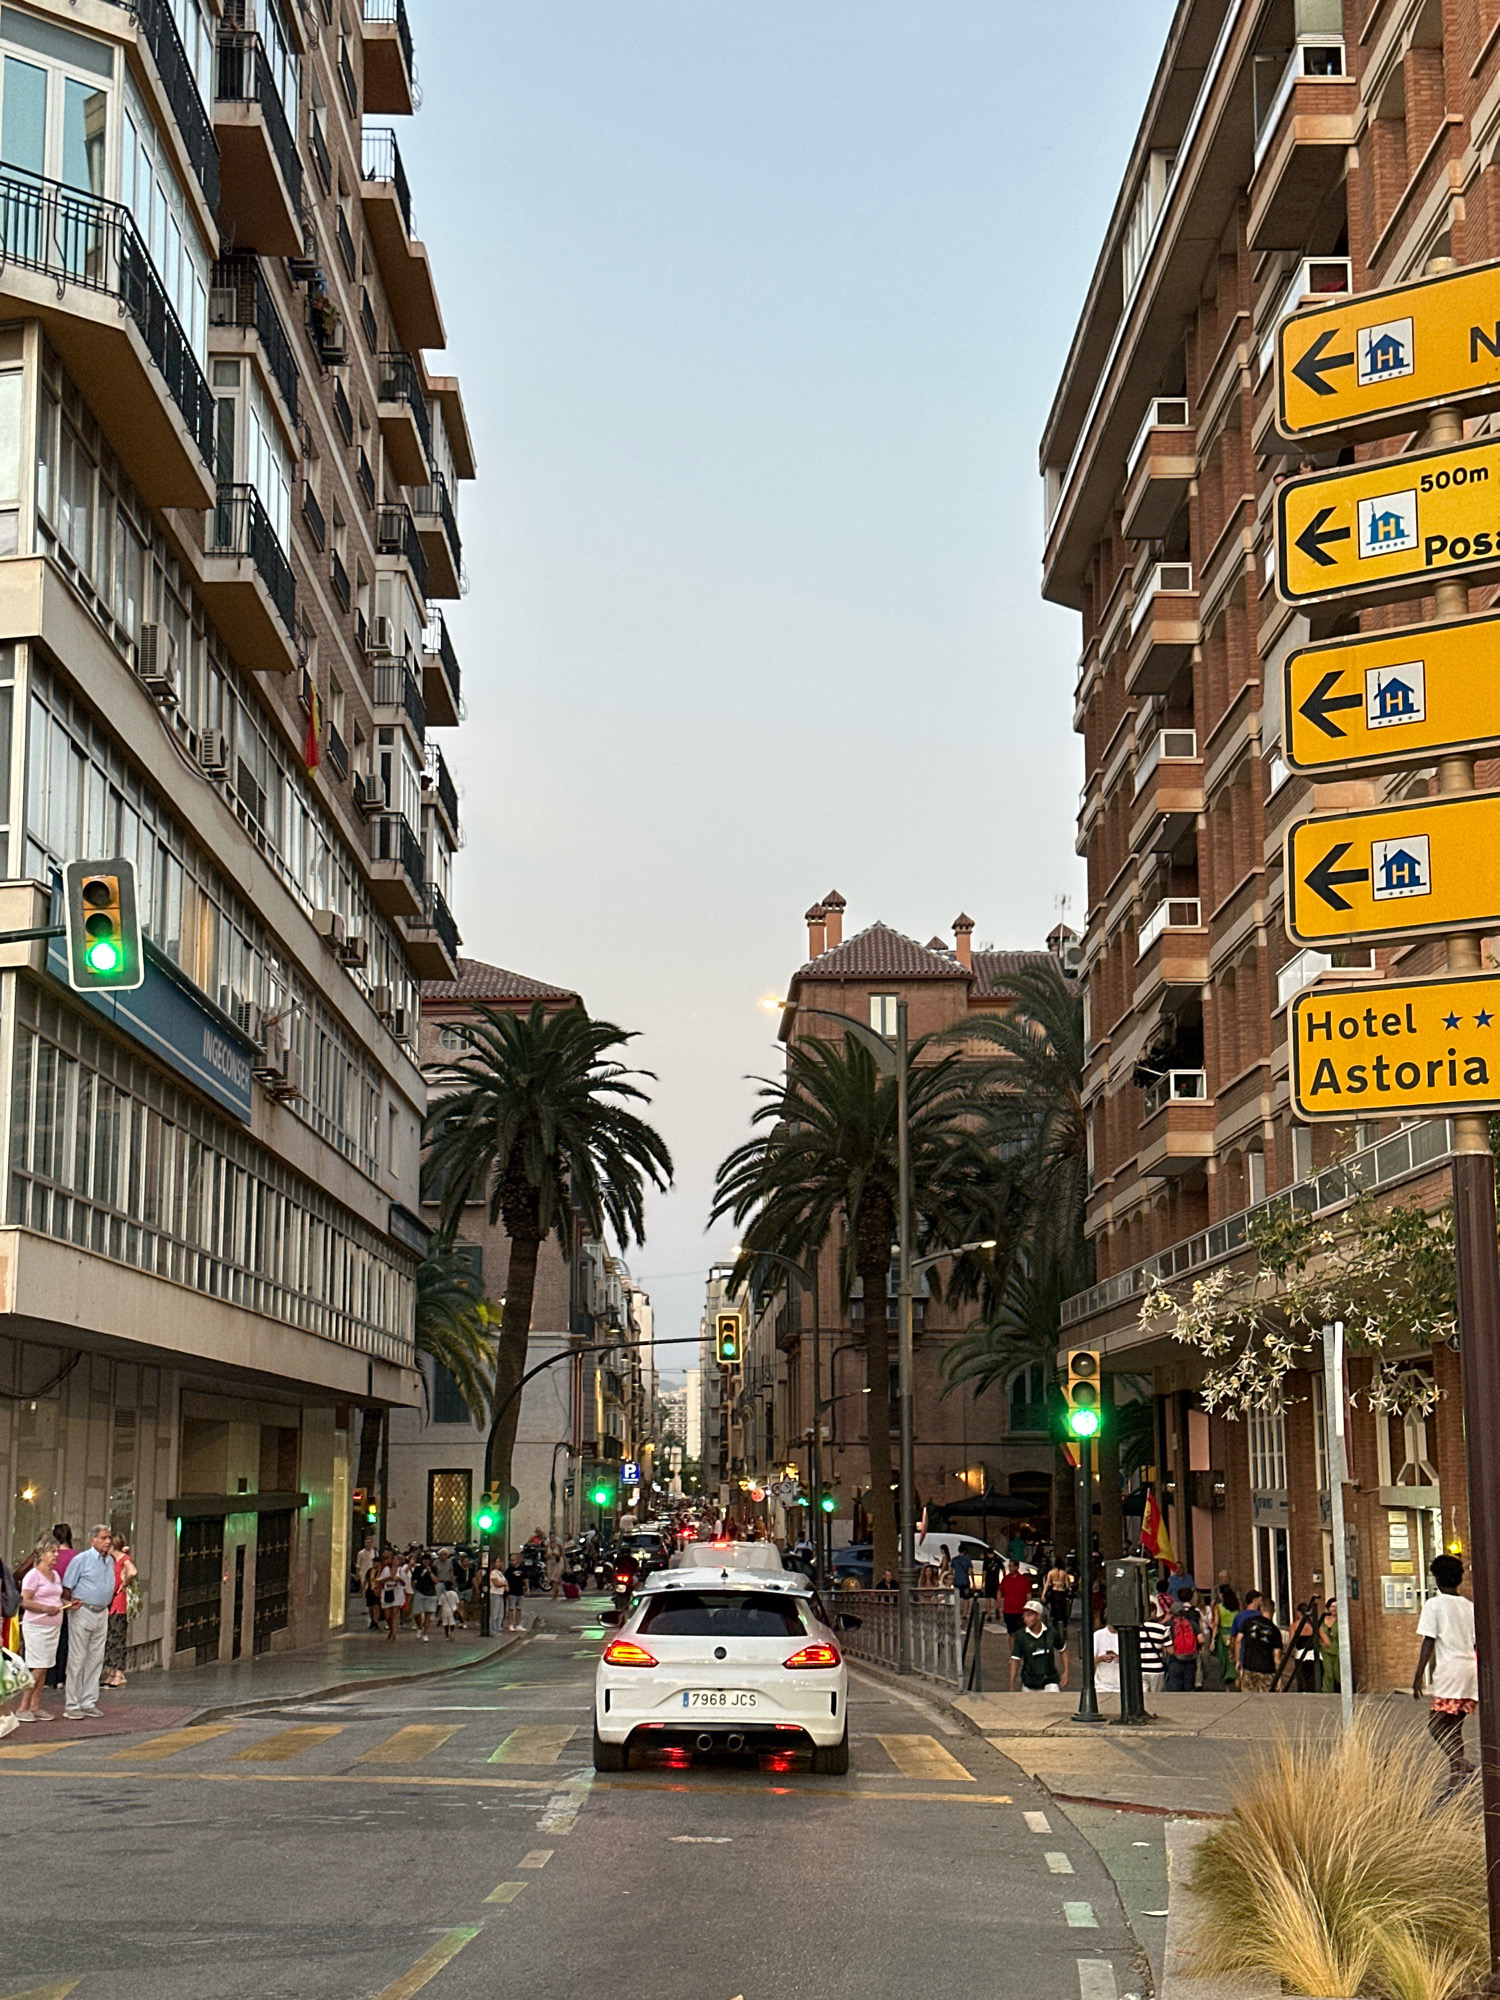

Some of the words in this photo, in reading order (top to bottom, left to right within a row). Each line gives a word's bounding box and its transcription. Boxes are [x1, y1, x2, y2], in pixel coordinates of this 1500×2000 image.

[1420, 467, 1489, 493] 500m
[1306, 1003, 1417, 1042] Hotel
[202, 1027, 250, 1094] INGECONSER
[1310, 1048, 1490, 1096] Astoria
[692, 1693, 727, 1706] 7968
[732, 1693, 757, 1706] JCS
